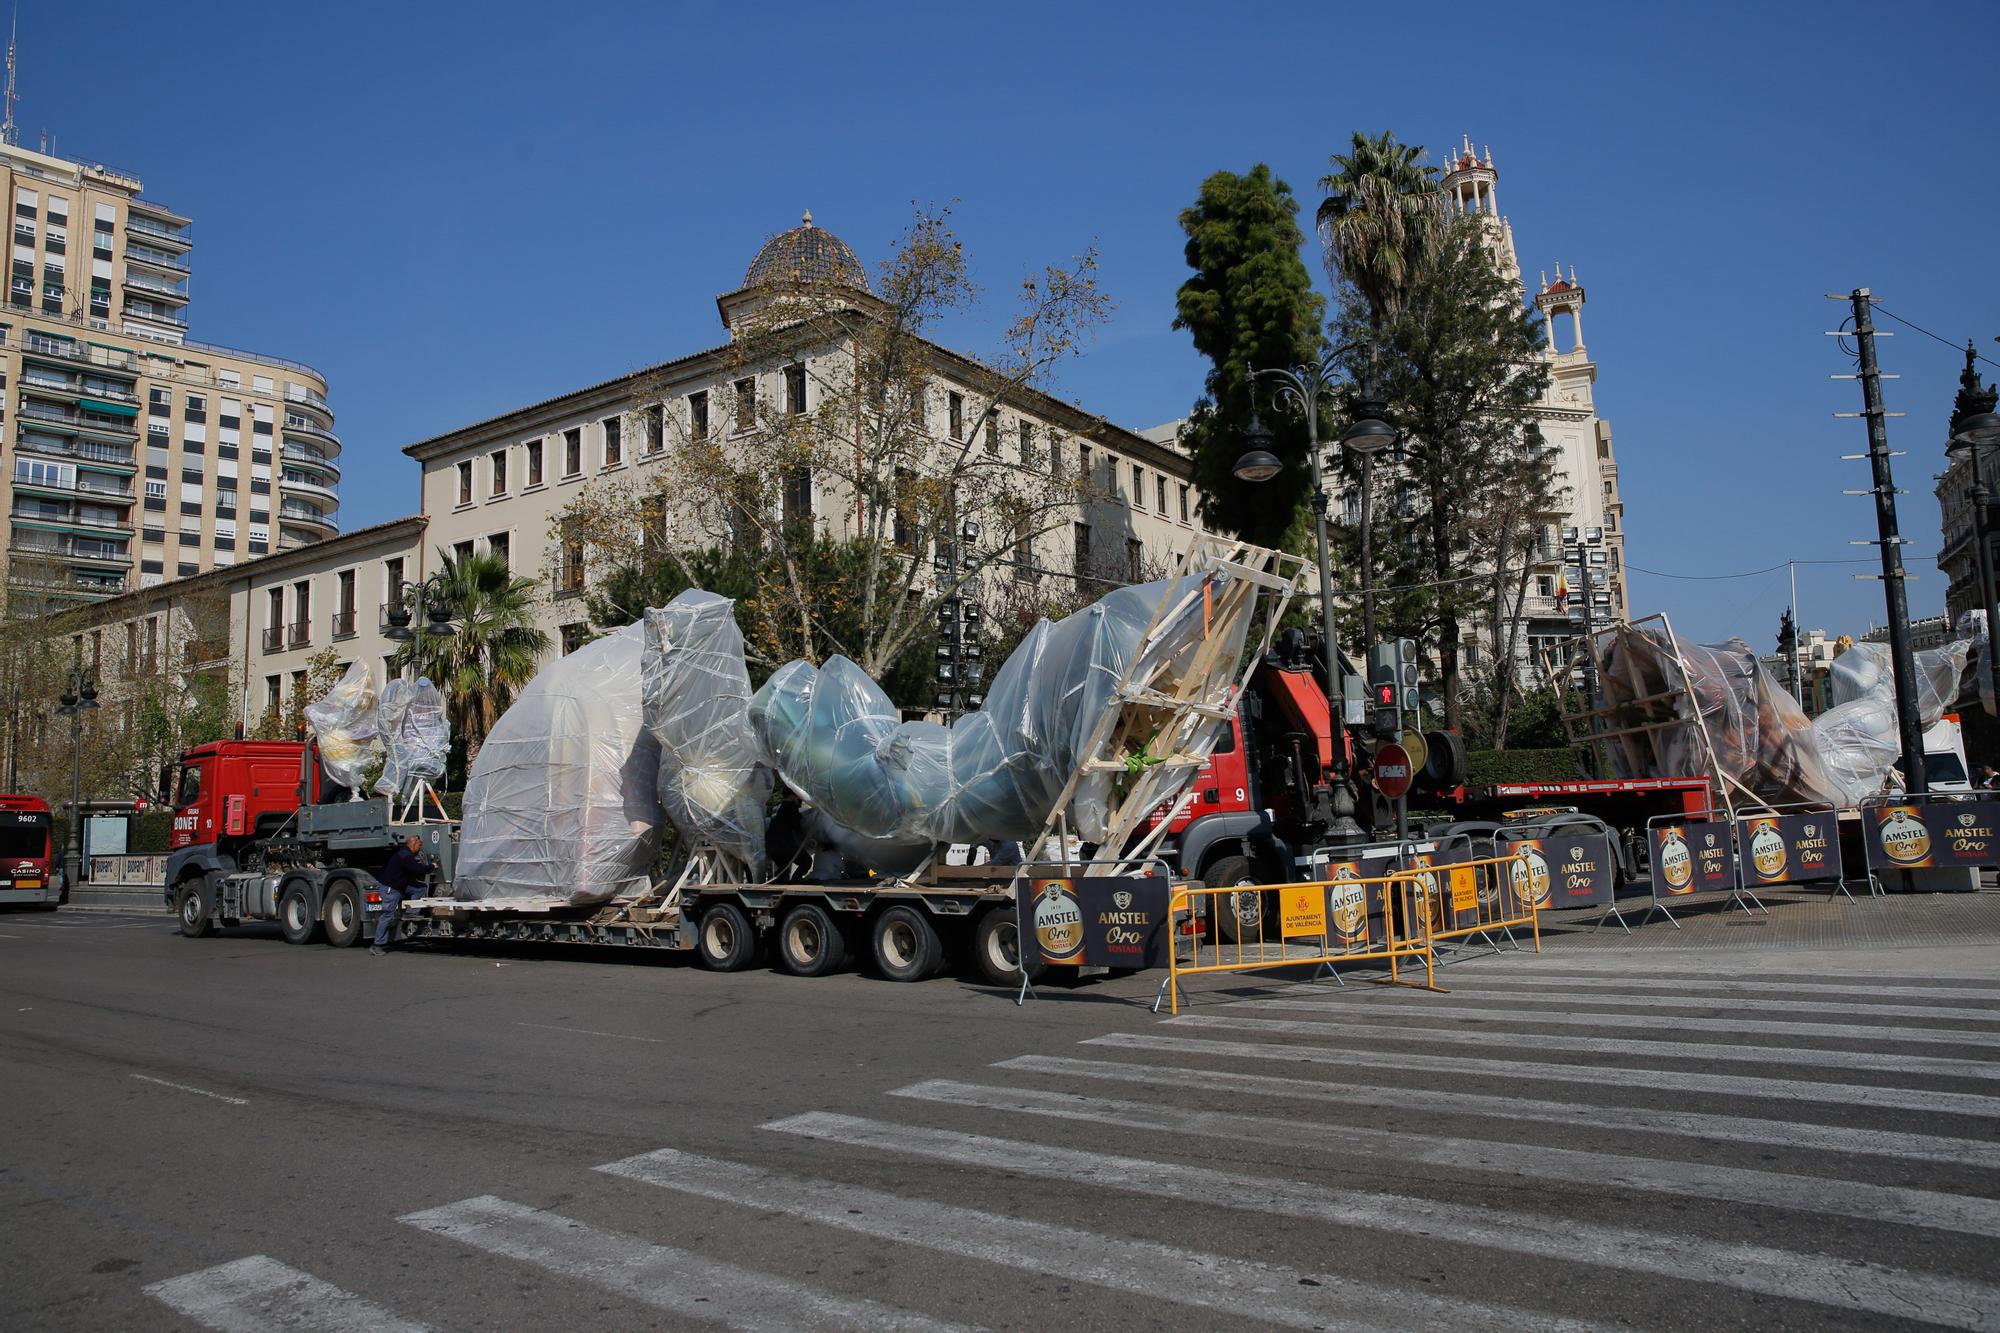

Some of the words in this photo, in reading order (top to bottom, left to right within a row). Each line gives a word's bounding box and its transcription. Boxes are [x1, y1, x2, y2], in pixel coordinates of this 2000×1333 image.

[1235, 788, 1245, 802] 9
[174, 816, 198, 830] BONET
[206, 818, 212, 829] 10
[1885, 829, 1926, 842] AMSTEL
[1945, 828, 1993, 838] AMSTEL
[1755, 841, 1783, 856] AMSTEL
[1796, 839, 1828, 850] AMSTEL
[1895, 841, 1918, 852] Oro
[1952, 838, 1988, 851] Oro
[1664, 852, 1689, 866] AMSTEL
[1699, 848, 1724, 860] AMSTEL
[1762, 855, 1778, 865] Oro
[1801, 850, 1825, 863] Oro
[1515, 865, 1546, 881] AMTEL
[1561, 862, 1597, 874] AMSTEL
[1670, 866, 1685, 876] Oro
[1704, 860, 1723, 873] Oro
[1567, 875, 1593, 889] Oro
[1038, 911, 1079, 927] AMSTEL
[1098, 912, 1149, 925] AMSTEL
[1286, 914, 1321, 922] AJUNTAMENT
[1047, 927, 1071, 940] Oro
[1106, 926, 1144, 943] Oro
